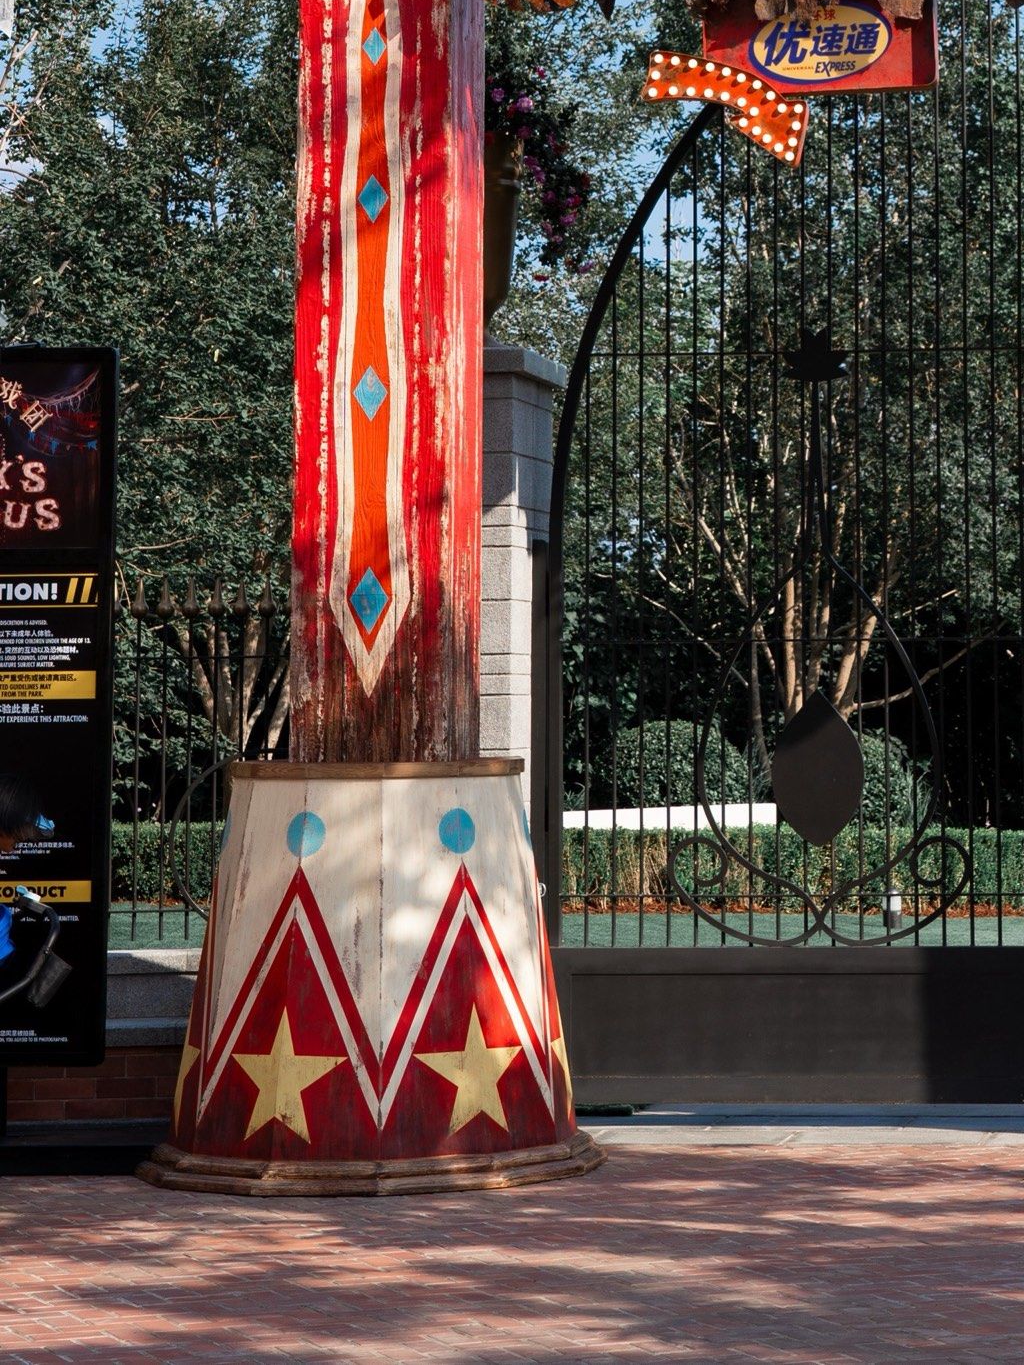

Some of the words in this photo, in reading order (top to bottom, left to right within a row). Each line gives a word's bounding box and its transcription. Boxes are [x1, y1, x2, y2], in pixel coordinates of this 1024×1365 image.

[764, 21, 881, 66] 优速通
[814, 60, 856, 77] EXPRESS
[3, 498, 62, 532] US
[6, 715, 39, 723] EXPERIENCE
[39, 715, 52, 723] THIS
